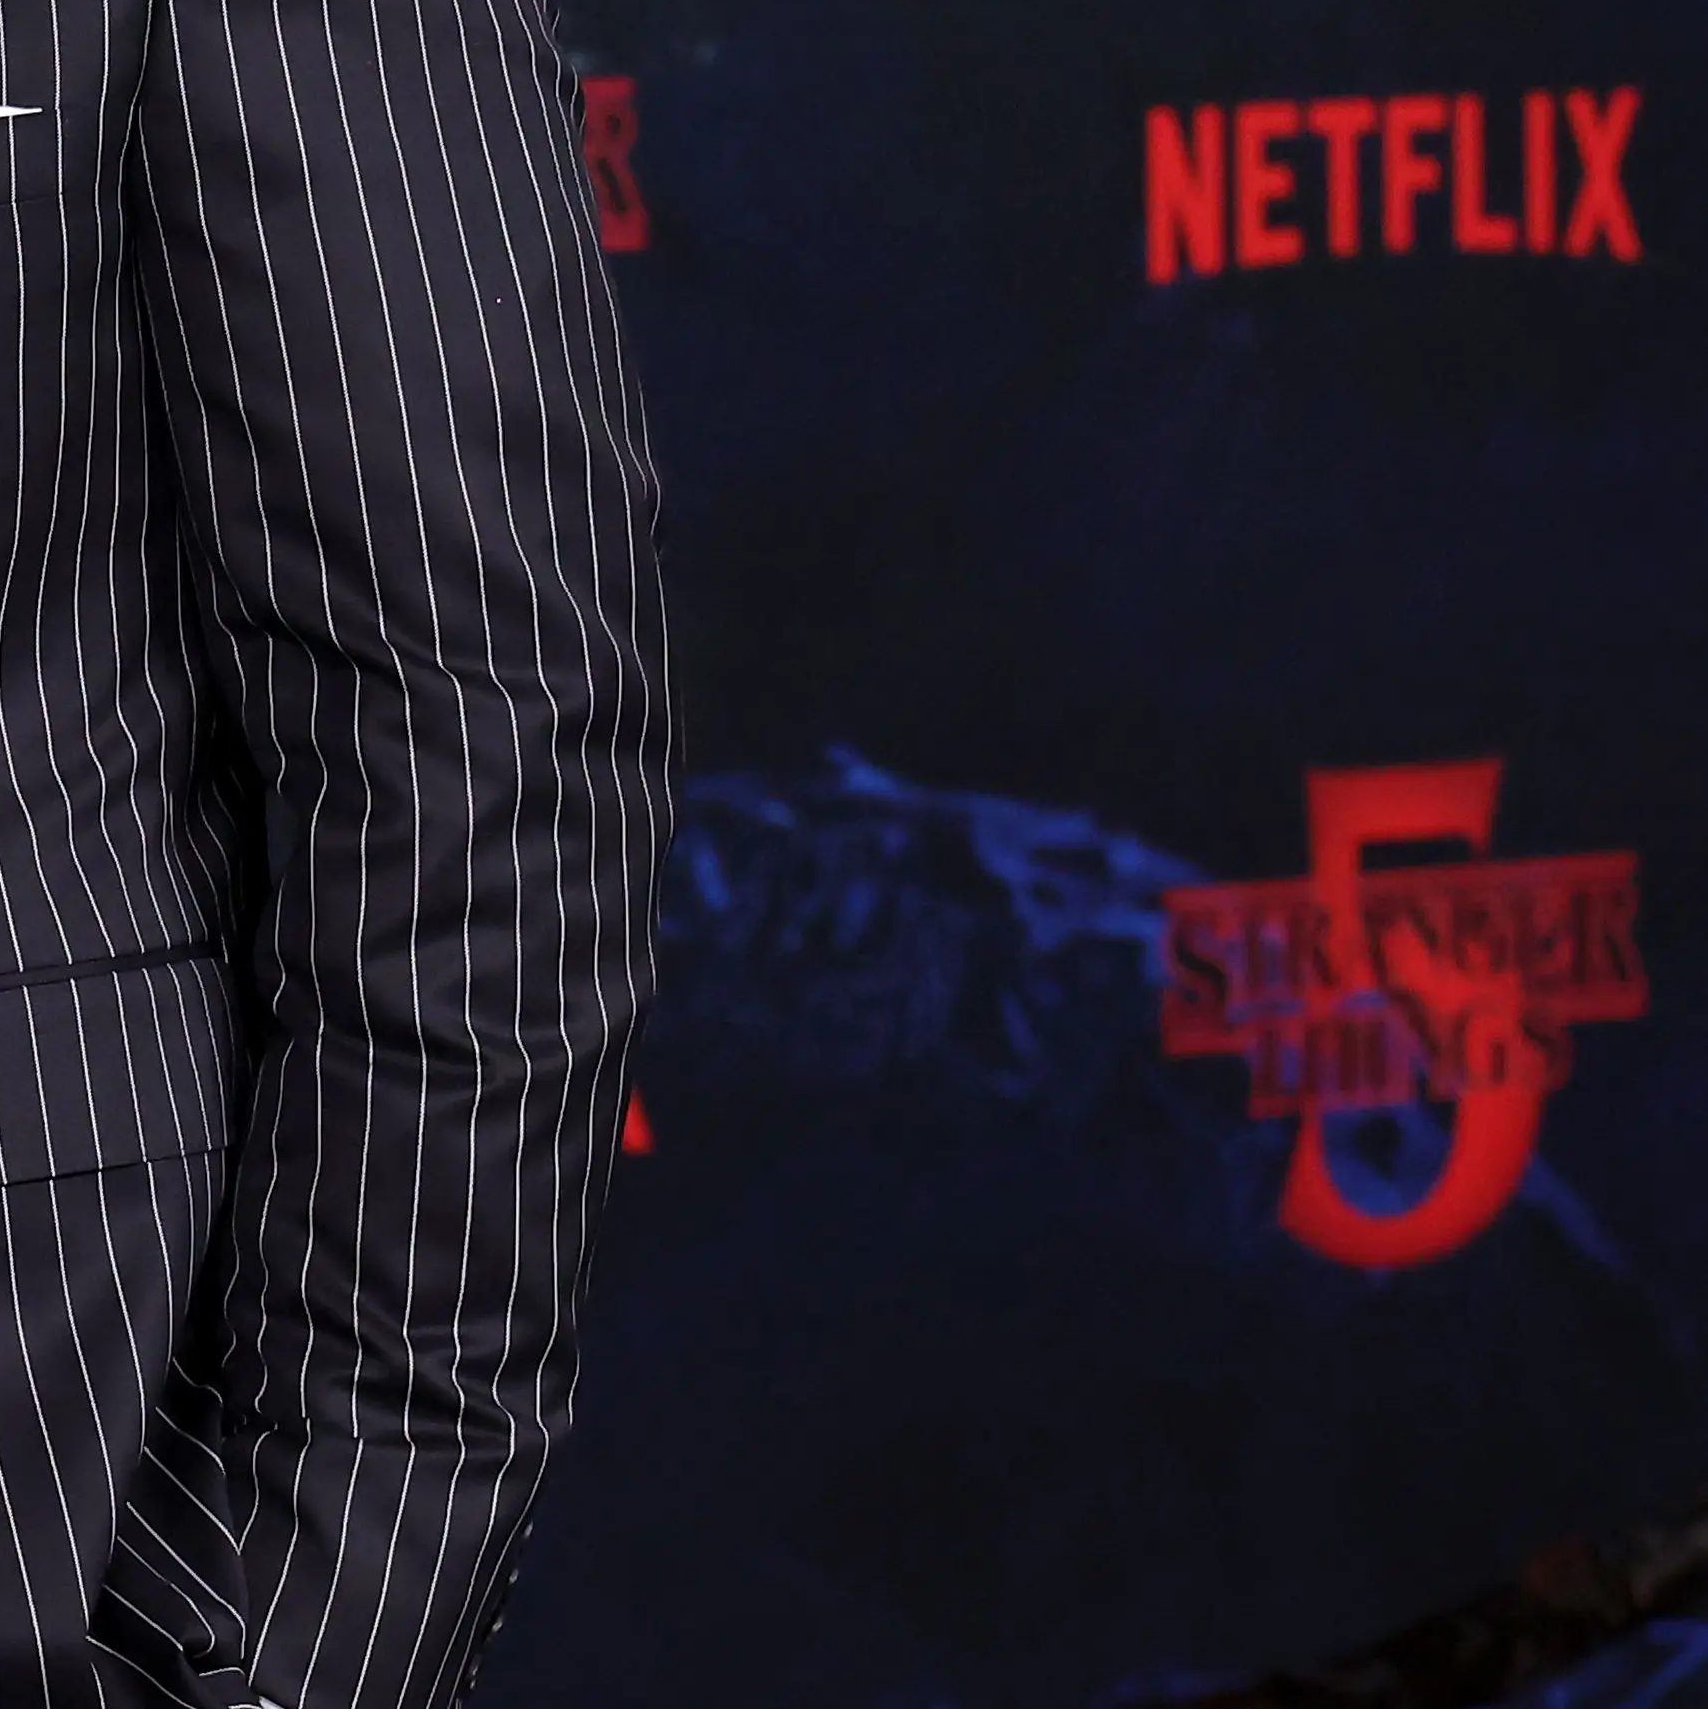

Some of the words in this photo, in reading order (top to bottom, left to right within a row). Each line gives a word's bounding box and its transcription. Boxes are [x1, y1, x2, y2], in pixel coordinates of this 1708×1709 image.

[1146, 85, 1643, 286] NETFLIX
[1161, 849, 1652, 1058] STRANGER
[1248, 987, 1576, 1120] THINGS
[1278, 758, 1547, 1270] 5
